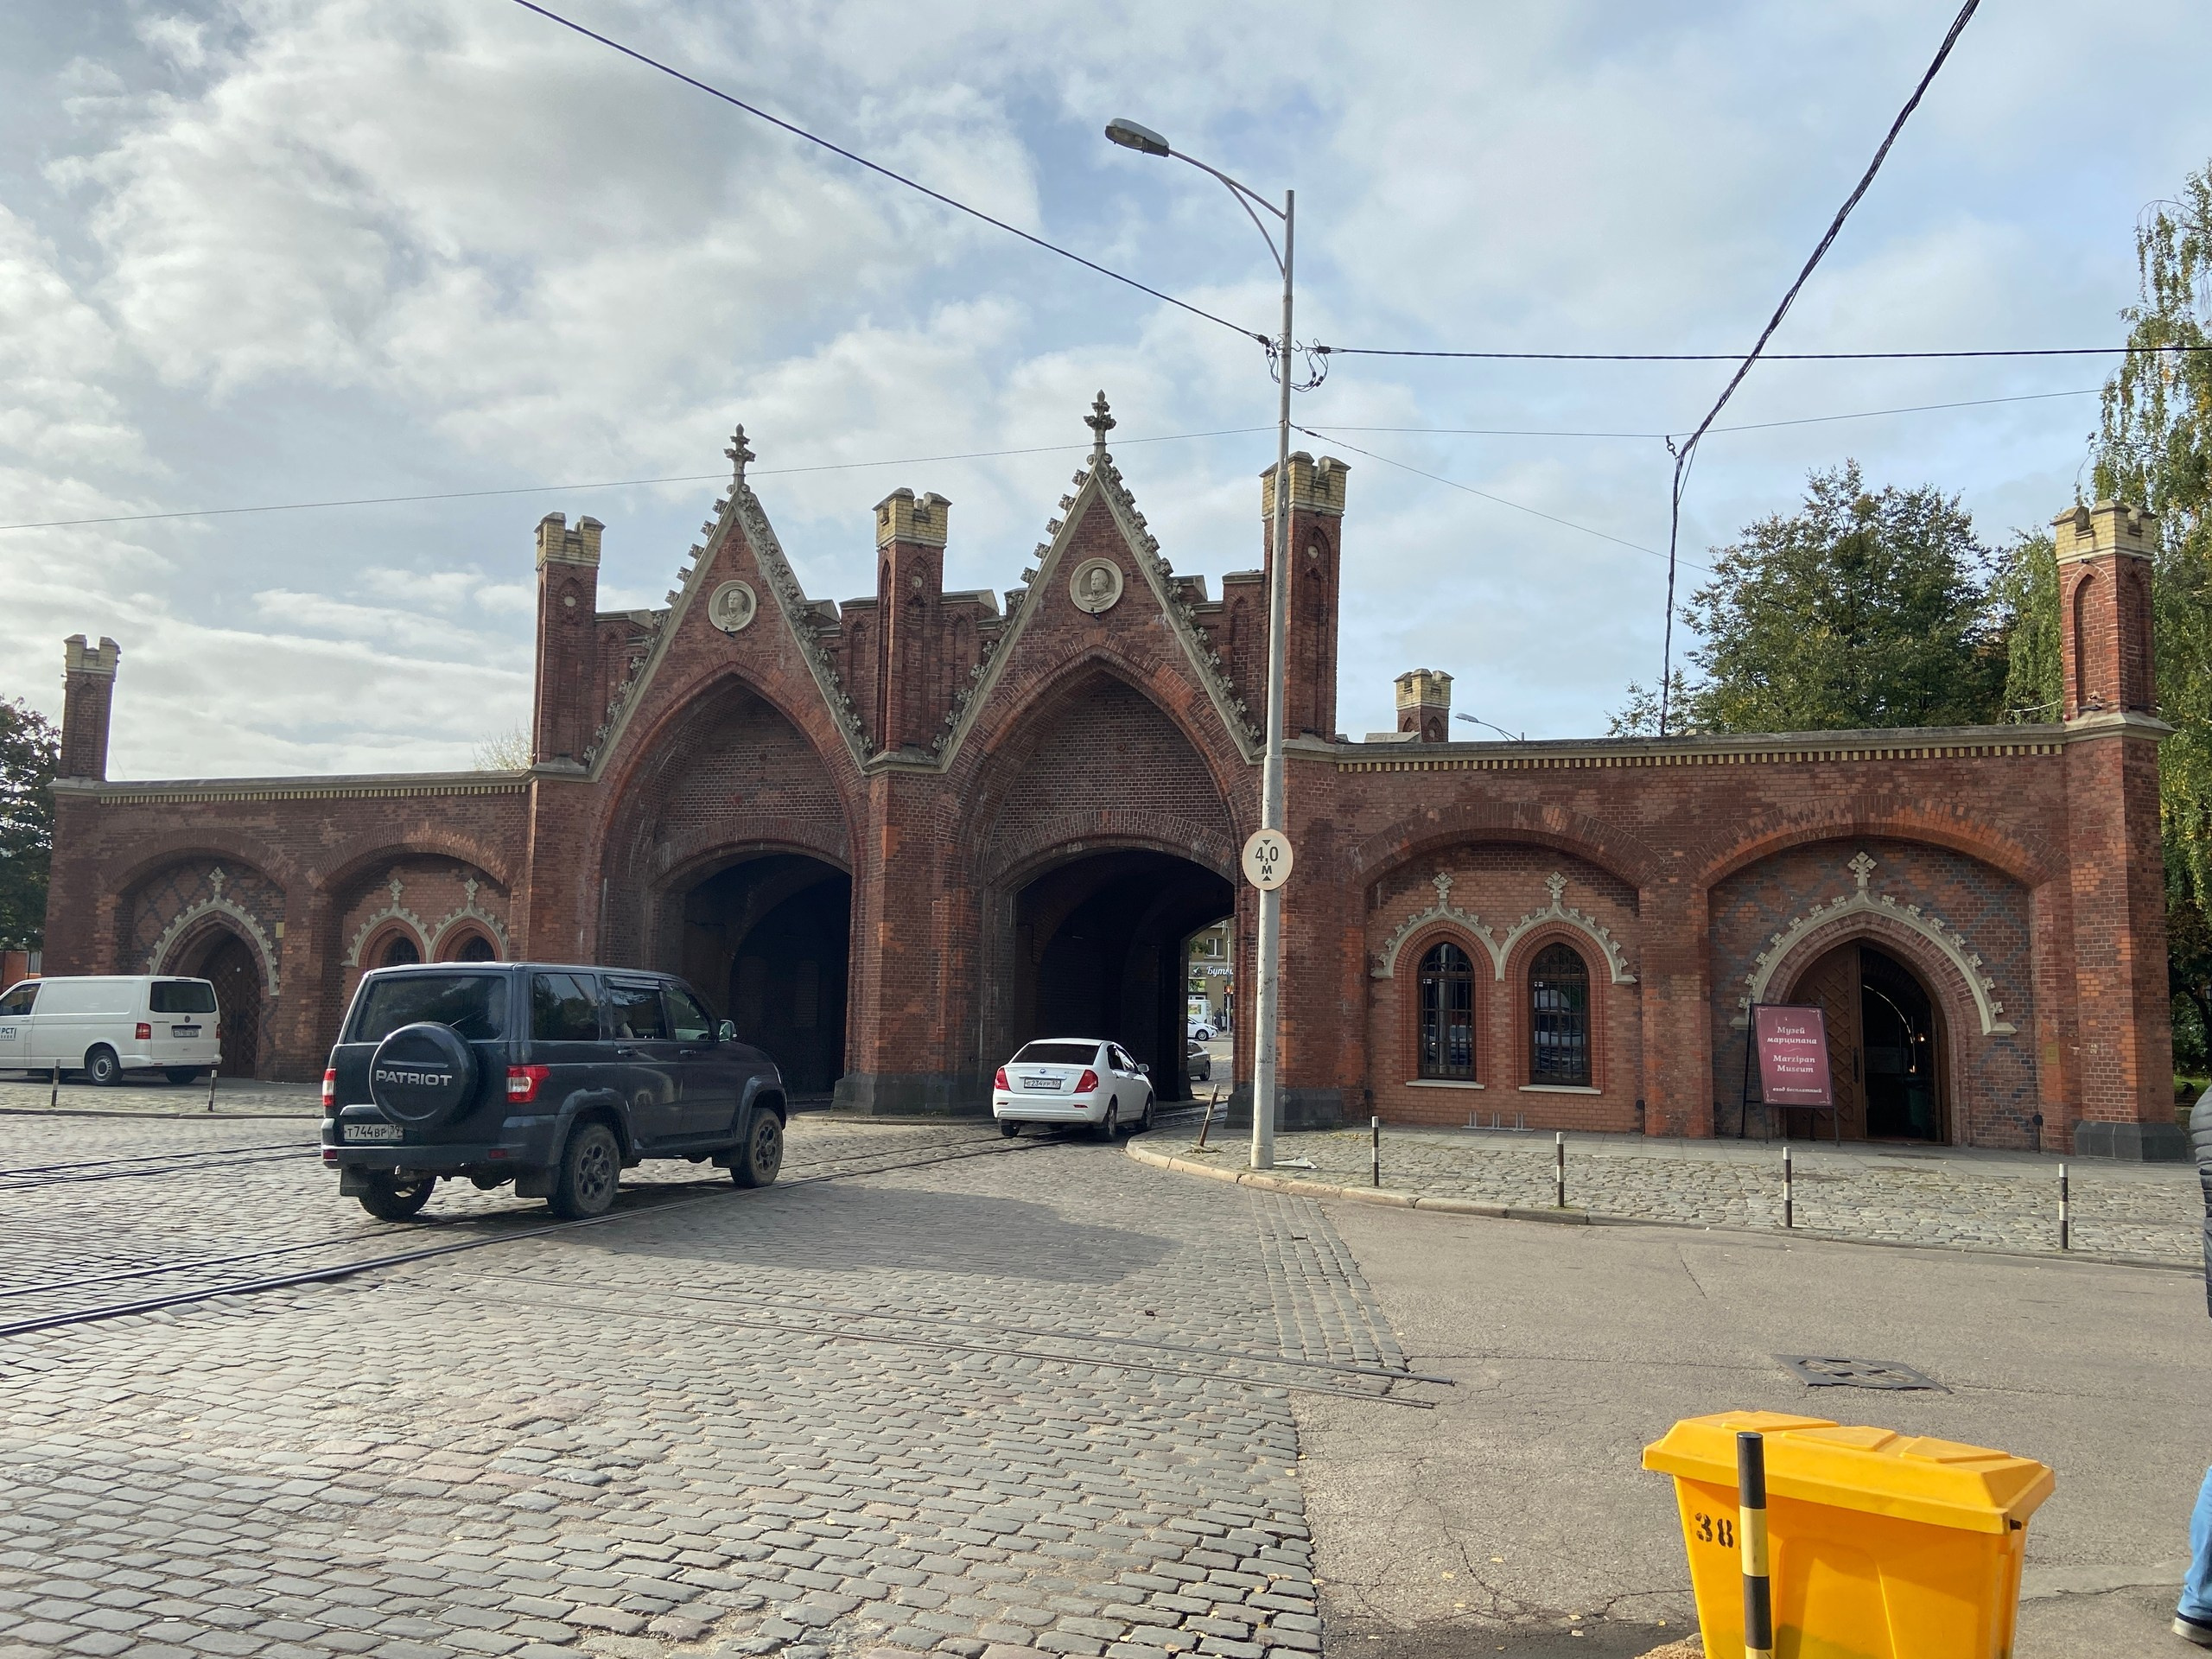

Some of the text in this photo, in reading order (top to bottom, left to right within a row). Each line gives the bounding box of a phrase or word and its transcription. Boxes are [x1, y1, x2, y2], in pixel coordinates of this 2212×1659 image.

[1255, 846, 1279, 865] 4,0
[1777, 1026, 1806, 1036] Музей
[1766, 1036, 1817, 1046] марципана
[1772, 1054, 1815, 1065] Marzipan
[1777, 1065, 1815, 1073] Museum
[375, 1070, 453, 1086] PATRIOT
[1694, 1512, 1734, 1548] 38
